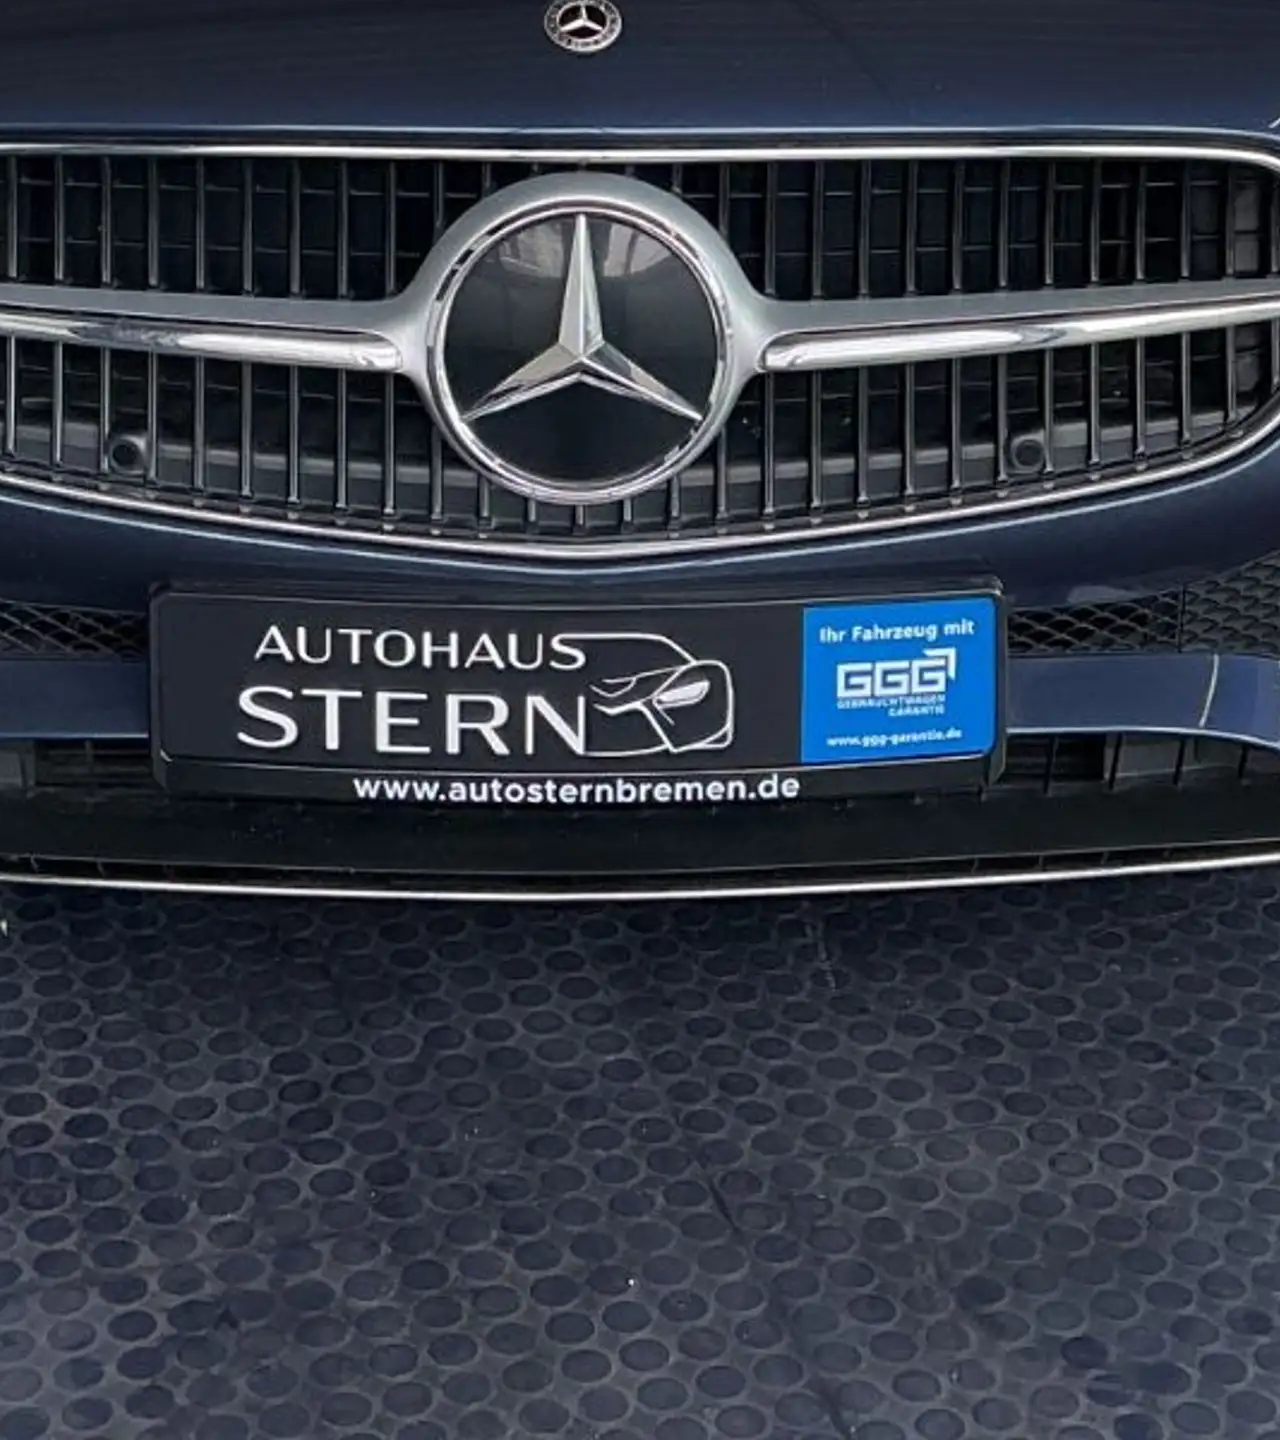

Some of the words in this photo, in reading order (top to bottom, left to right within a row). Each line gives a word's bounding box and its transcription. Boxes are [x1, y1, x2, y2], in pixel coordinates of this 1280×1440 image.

[254, 625, 587, 671] AUTOHAUS
[819, 626, 846, 643] Ihr
[851, 622, 938, 642] Fahrzeug
[944, 617, 976, 636] mit
[836, 658, 947, 698] GGG
[236, 683, 587, 757] STERN
[353, 772, 801, 806] www.autosternbremen.de
